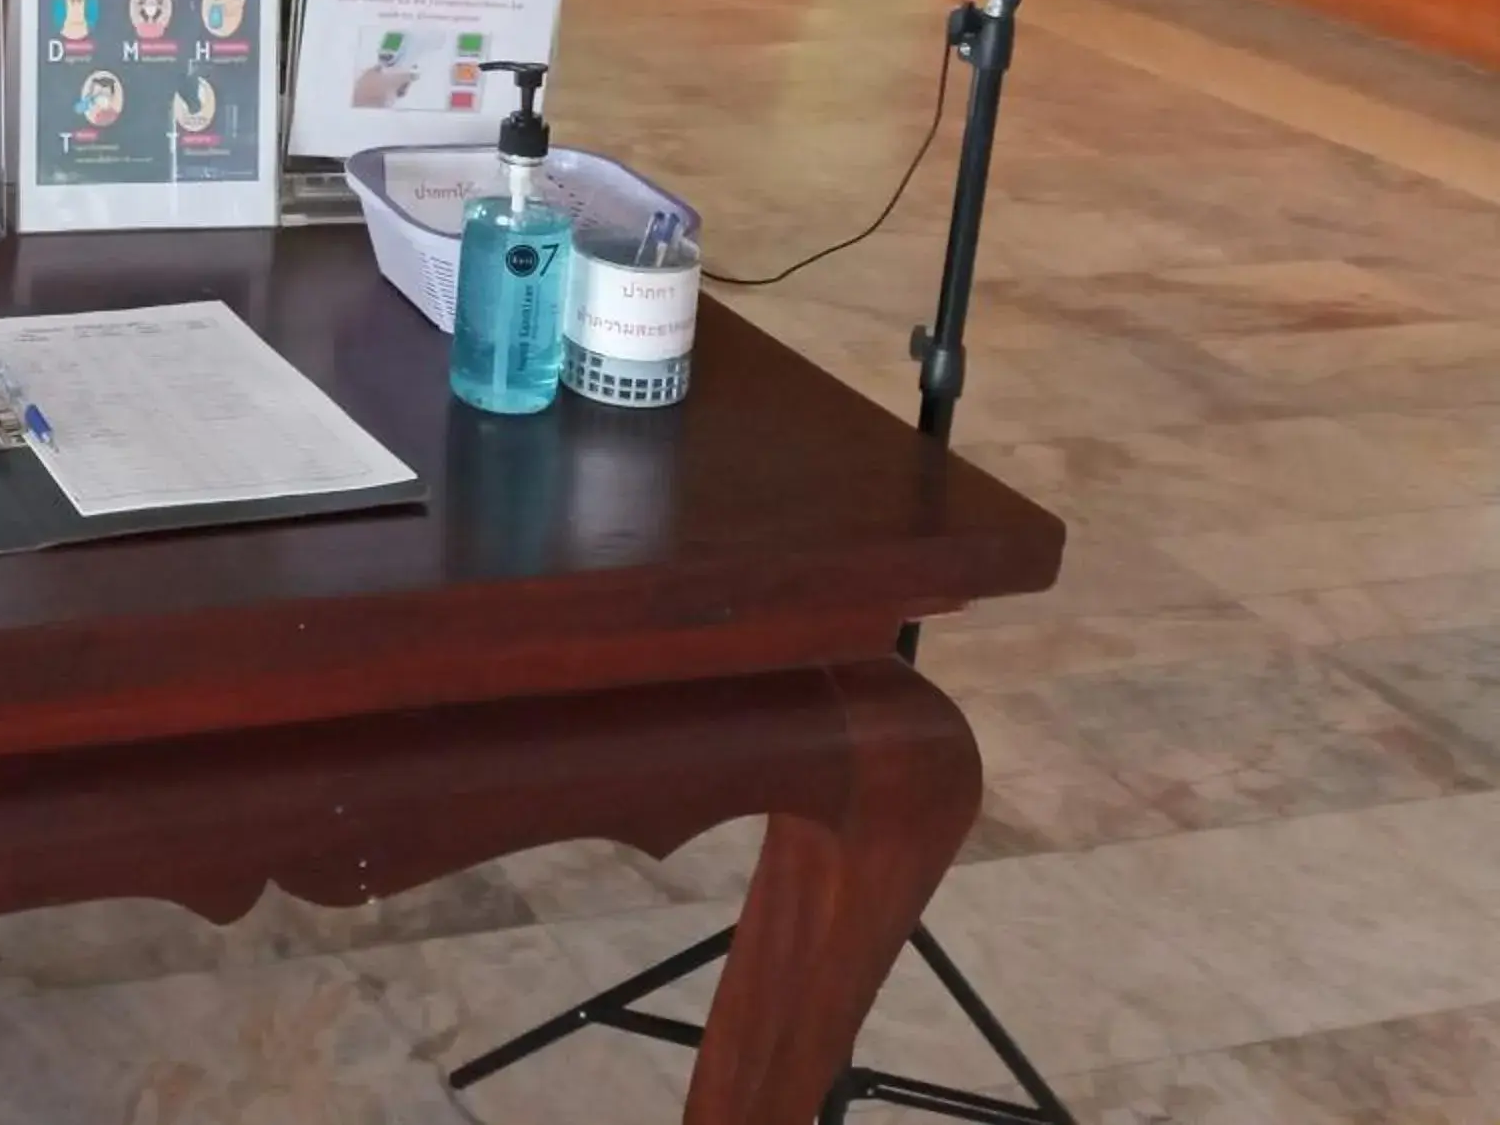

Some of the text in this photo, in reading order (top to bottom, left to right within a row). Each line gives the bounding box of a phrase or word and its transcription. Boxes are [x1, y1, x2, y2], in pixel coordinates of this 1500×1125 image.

[49, 40, 64, 62] D
[123, 41, 139, 62] M
[195, 41, 210, 62] H
[60, 132, 72, 154] T
[541, 243, 559, 277] 7
[622, 282, 676, 300] ปากกา
